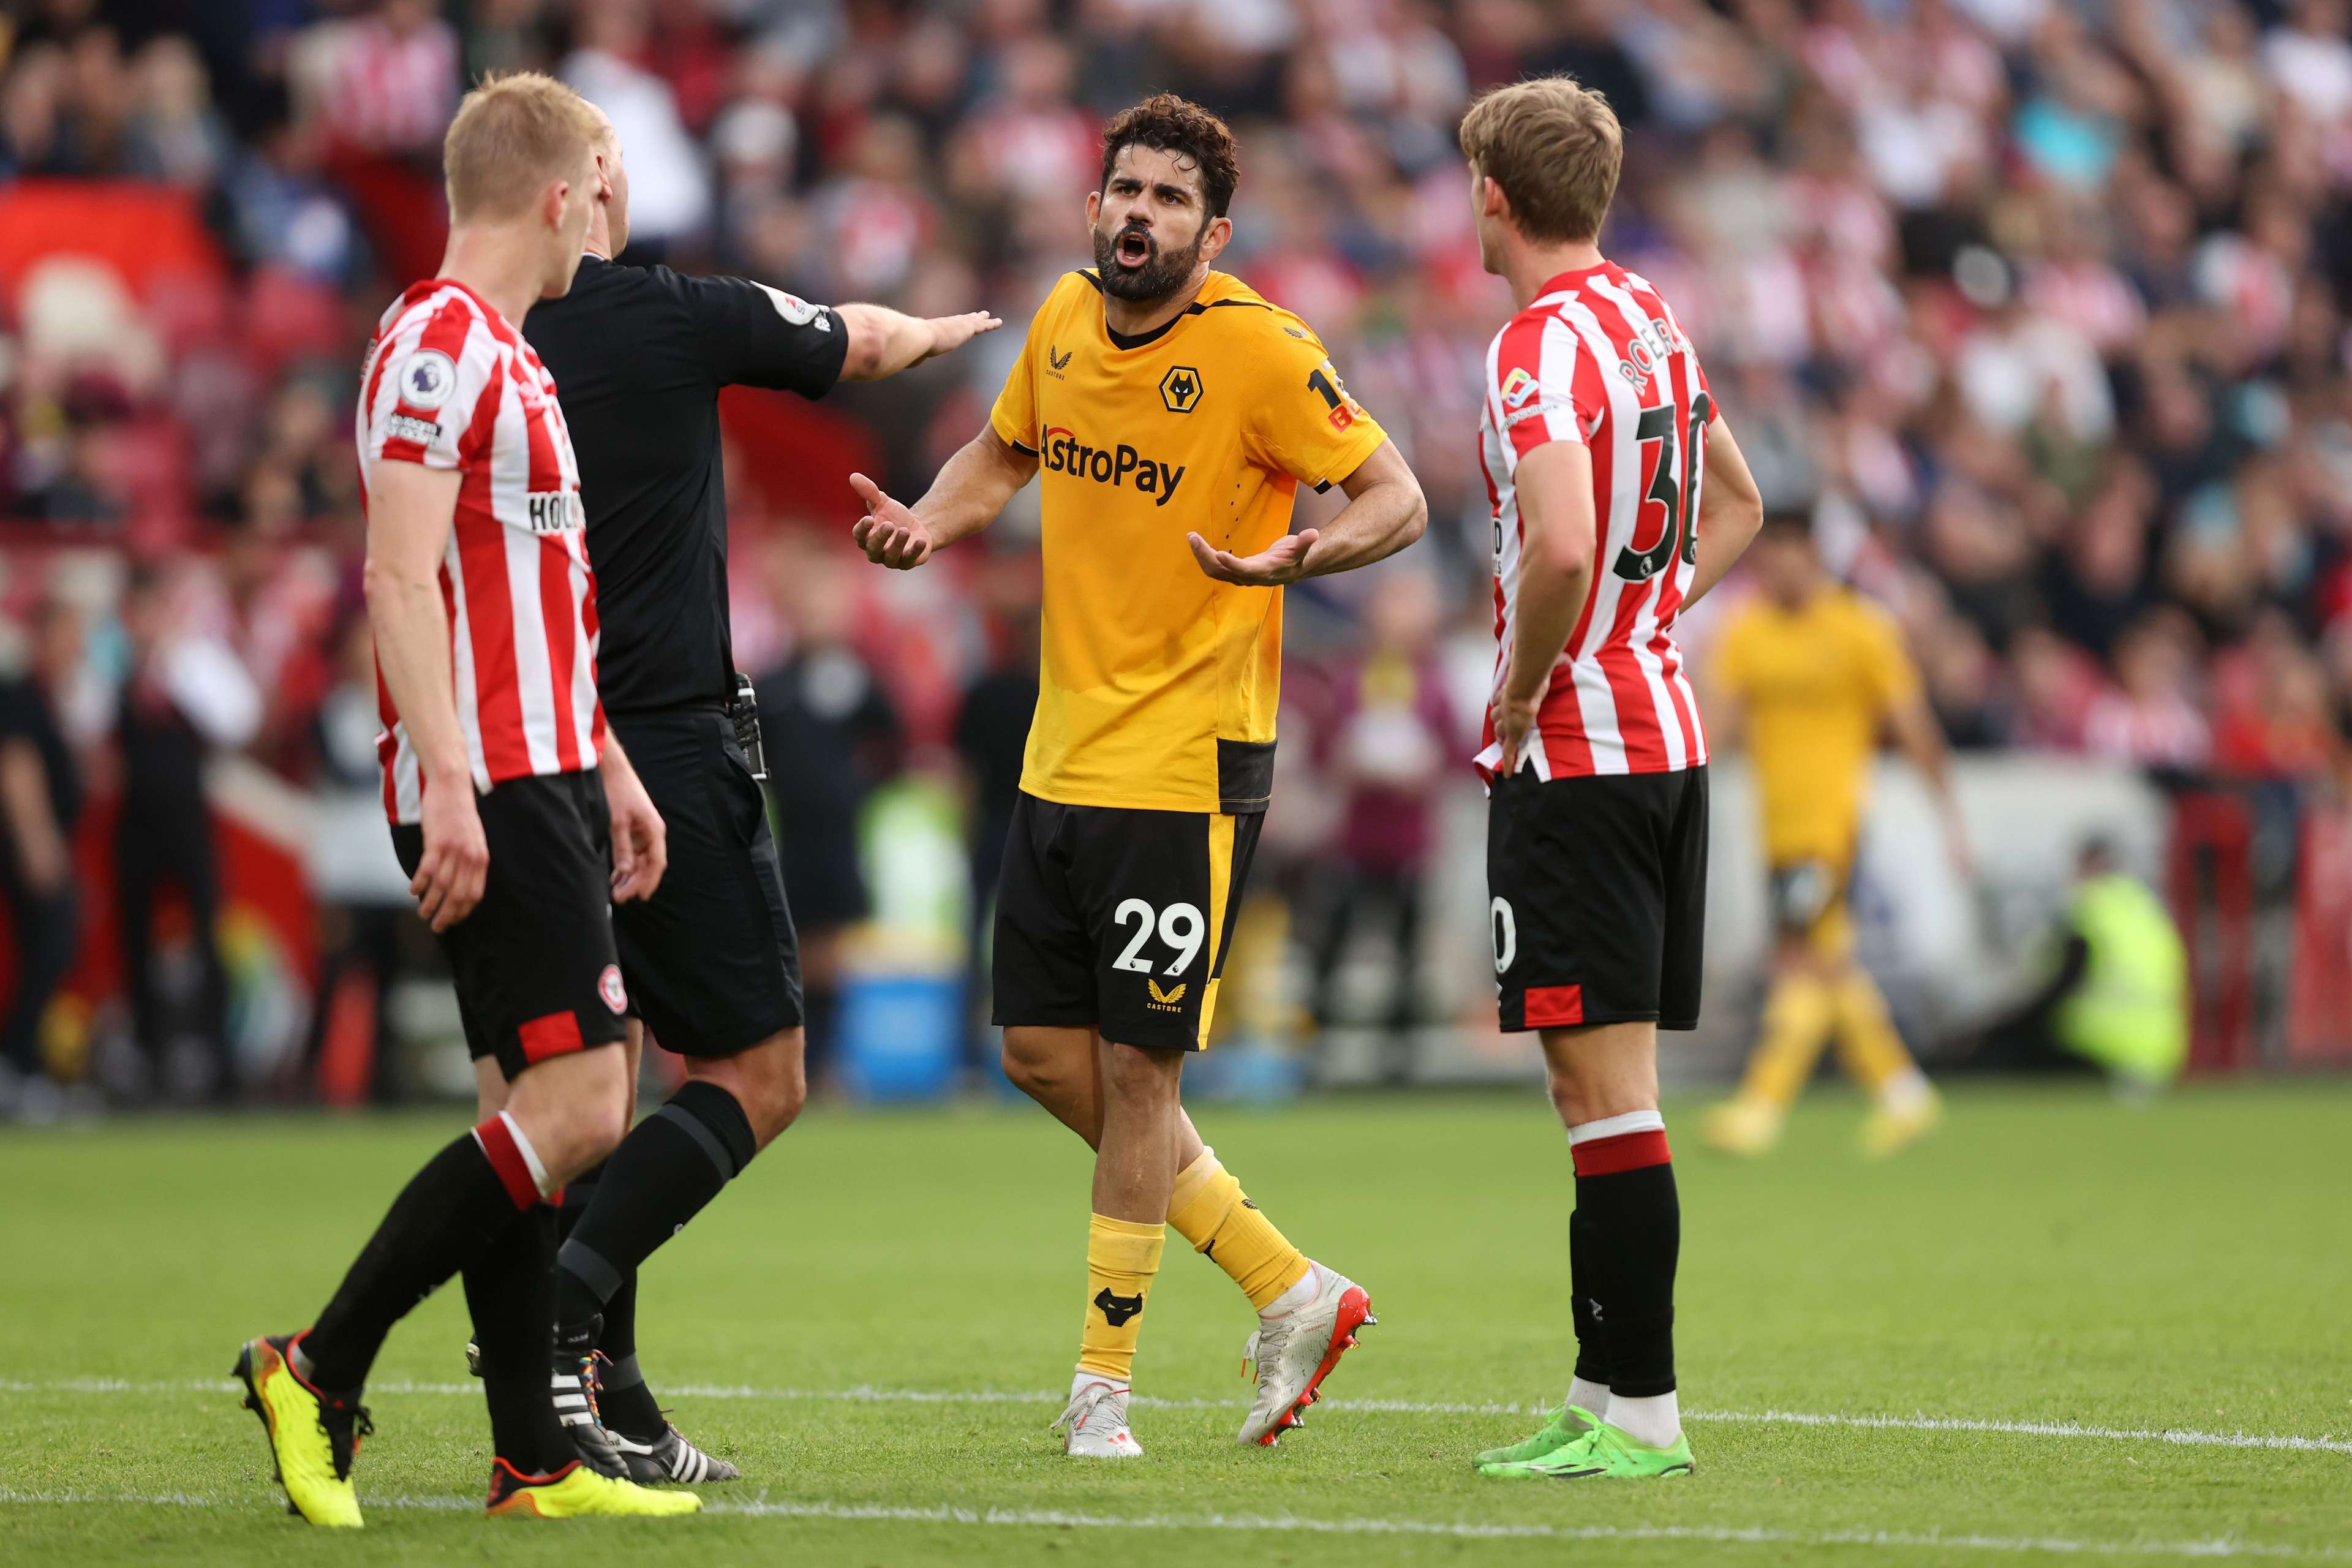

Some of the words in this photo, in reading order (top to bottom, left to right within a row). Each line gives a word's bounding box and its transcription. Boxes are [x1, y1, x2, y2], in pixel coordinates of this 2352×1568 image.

[1041, 424, 1186, 507] AstroPay
[1613, 393, 1709, 580] 30
[1112, 898, 1205, 977] 29
[1147, 1003, 1182, 1013] CASTORE
